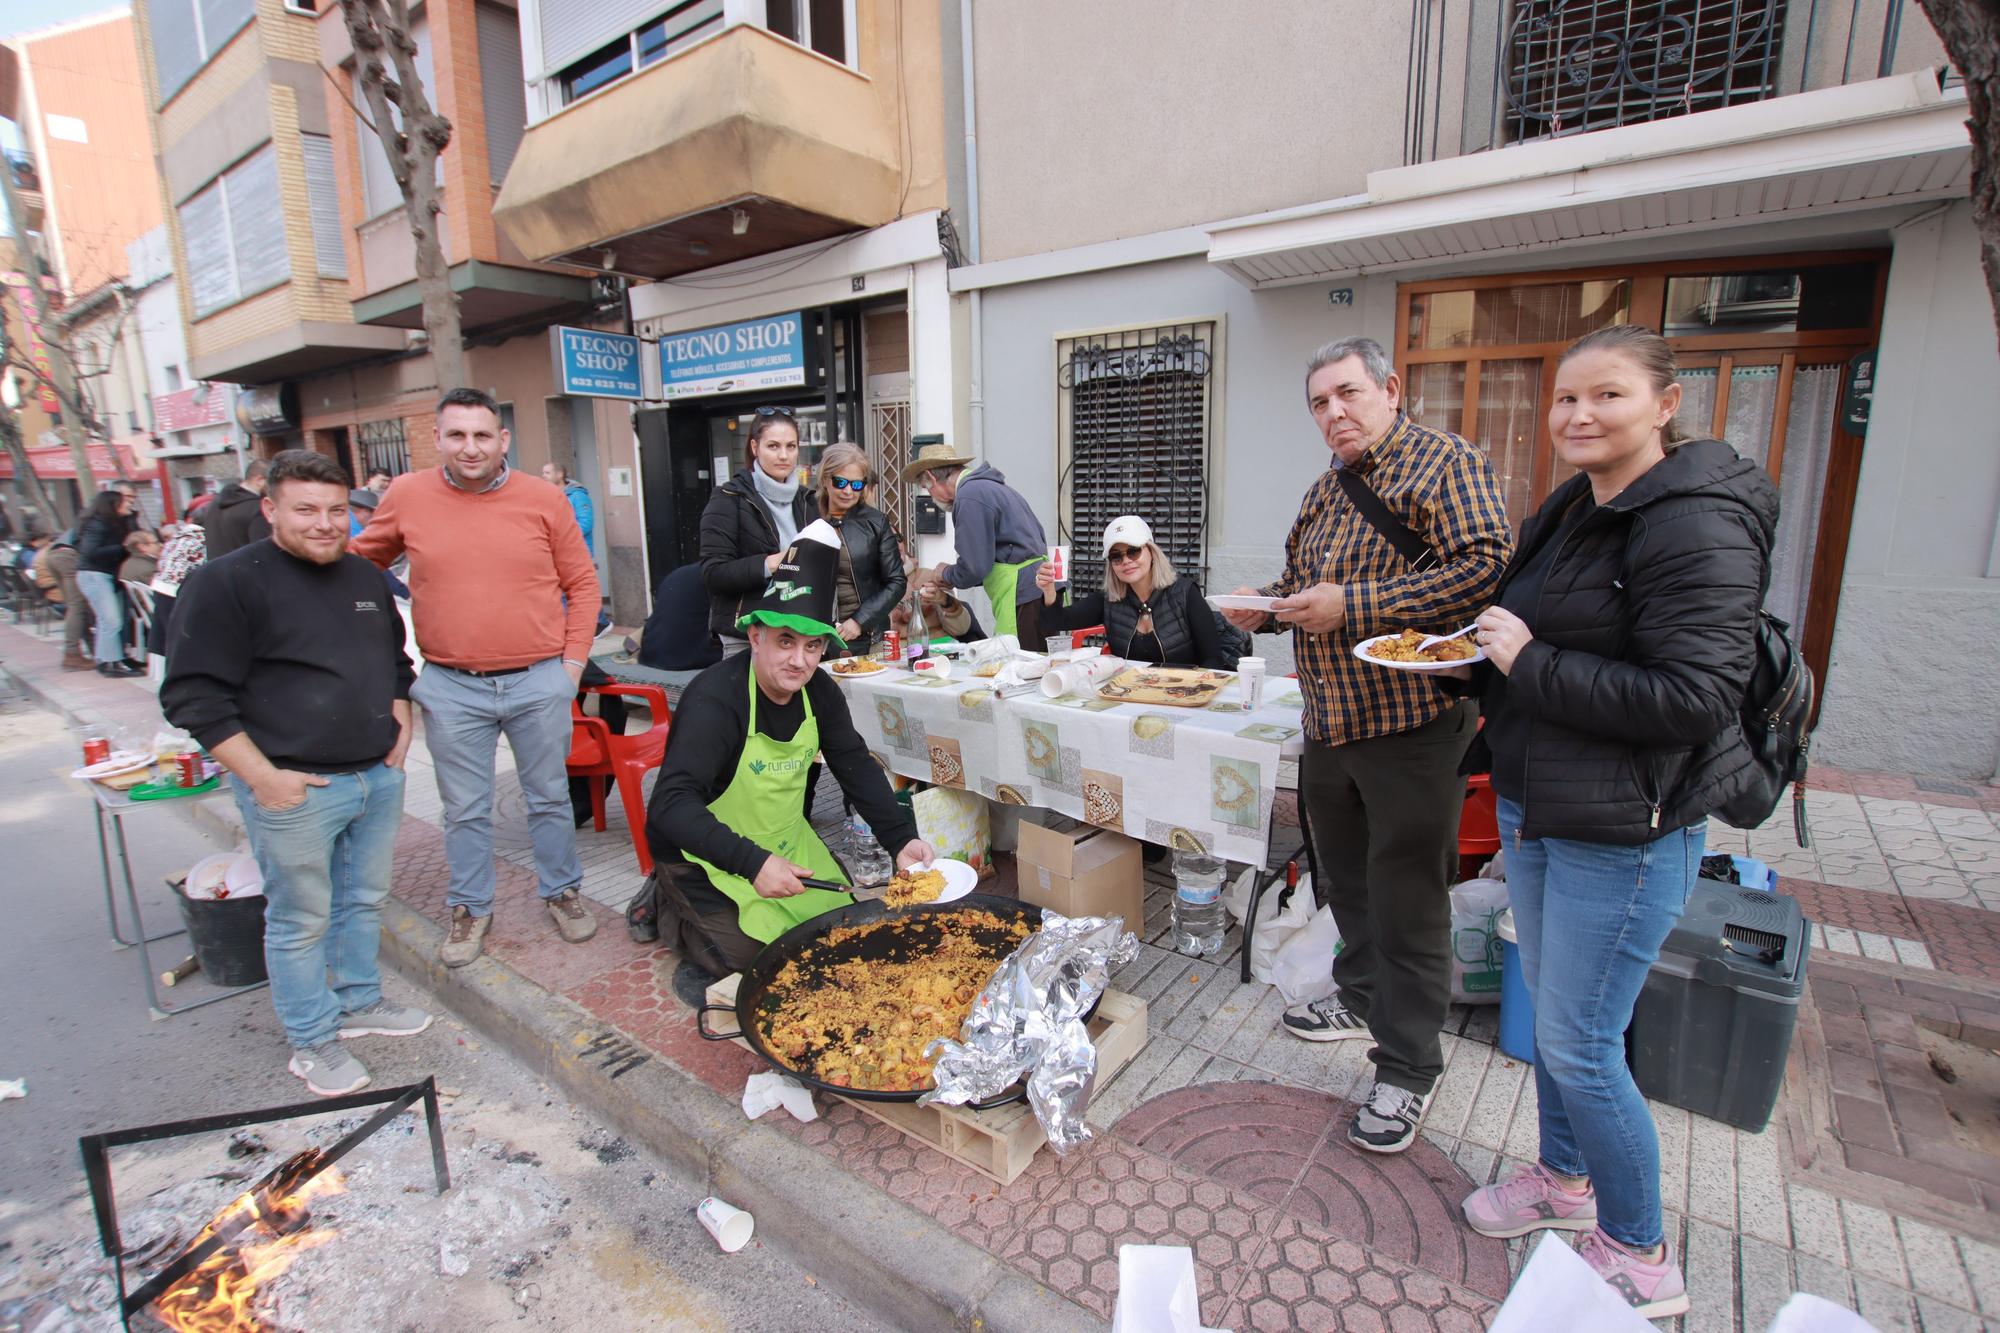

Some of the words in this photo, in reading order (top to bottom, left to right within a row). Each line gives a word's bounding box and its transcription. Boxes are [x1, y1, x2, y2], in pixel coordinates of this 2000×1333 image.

[1332, 291, 1349, 305] 52
[566, 334, 634, 357] TECNO
[663, 331, 731, 363] TECNO
[735, 320, 796, 353] SHOP
[575, 351, 628, 372] SHOP
[750, 353, 792, 368] COMPLEMENTOS
